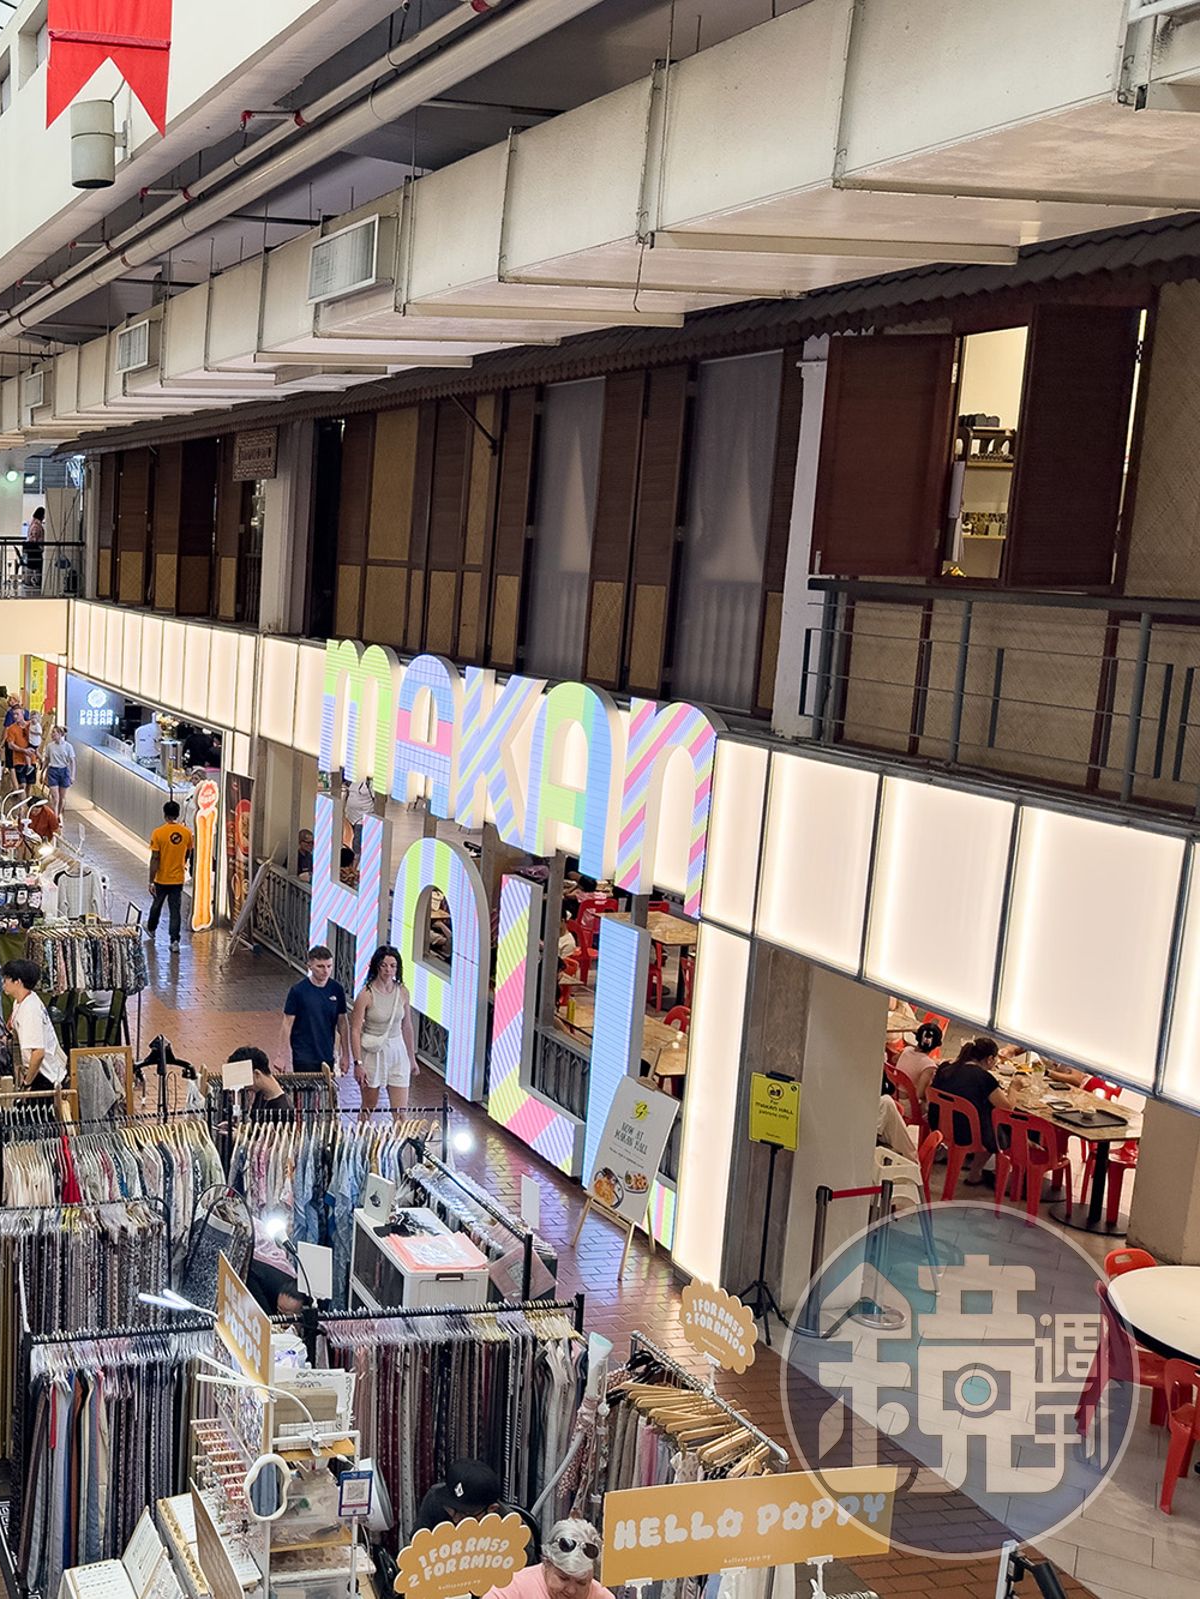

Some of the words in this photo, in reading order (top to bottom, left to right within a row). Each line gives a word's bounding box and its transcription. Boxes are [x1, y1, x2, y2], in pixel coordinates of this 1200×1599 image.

[80, 709, 114, 717] PASAR
[318, 638, 717, 919] MAKAN
[308, 793, 678, 1250] HALL
[698, 1299, 718, 1317] FOR
[224, 1301, 261, 1374] POPPY
[685, 1312, 693, 1325] 2
[694, 1312, 714, 1331] FOR
[713, 1321, 746, 1357] RM100
[613, 1508, 743, 1550] HELLO
[757, 1493, 887, 1535] POPPY
[408, 1573, 420, 1588] 2
[424, 1558, 457, 1581] FOR
[459, 1555, 515, 1570] RM100
[429, 1540, 463, 1563] FOR
[465, 1536, 510, 1553] RM59
